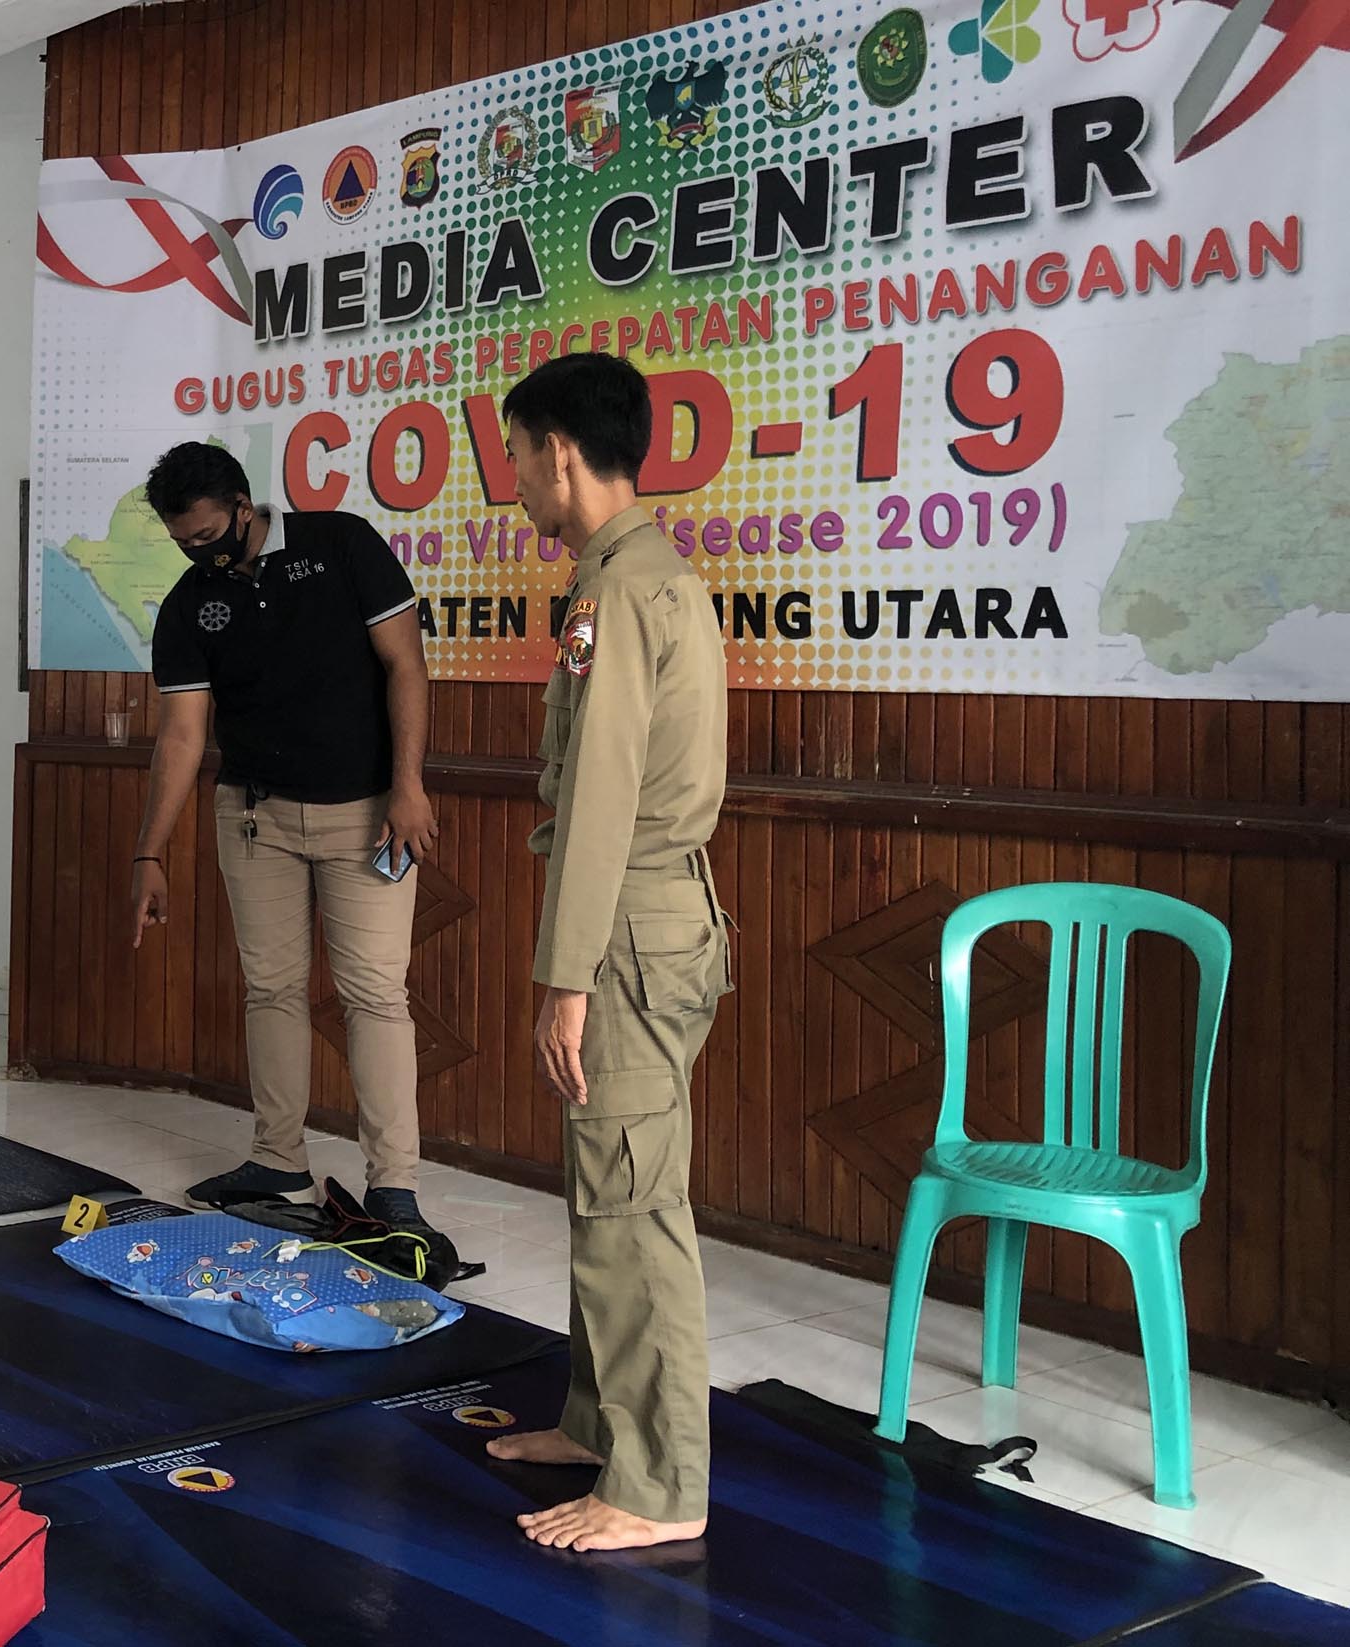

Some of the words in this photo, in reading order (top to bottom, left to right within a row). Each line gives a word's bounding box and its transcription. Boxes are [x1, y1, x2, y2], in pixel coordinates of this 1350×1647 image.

[254, 216, 545, 346] MEDIA
[589, 94, 1155, 286] CENTER
[174, 363, 306, 415] GUGUS
[324, 342, 456, 398] TUGAS
[475, 294, 772, 379] PERCEPATAN
[803, 214, 1301, 337] PENANGANAN
[283, 328, 1064, 513] COVD-19
[465, 514, 579, 563] Viru
[655, 505, 845, 558] isease
[876, 482, 1068, 552] 2019)
[288, 567, 312, 583] KSA
[313, 562, 325, 574] 16
[841, 586, 1069, 640] UTARA
[73, 1203, 90, 1229] 2
[137, 1453, 206, 1473] BNPB
